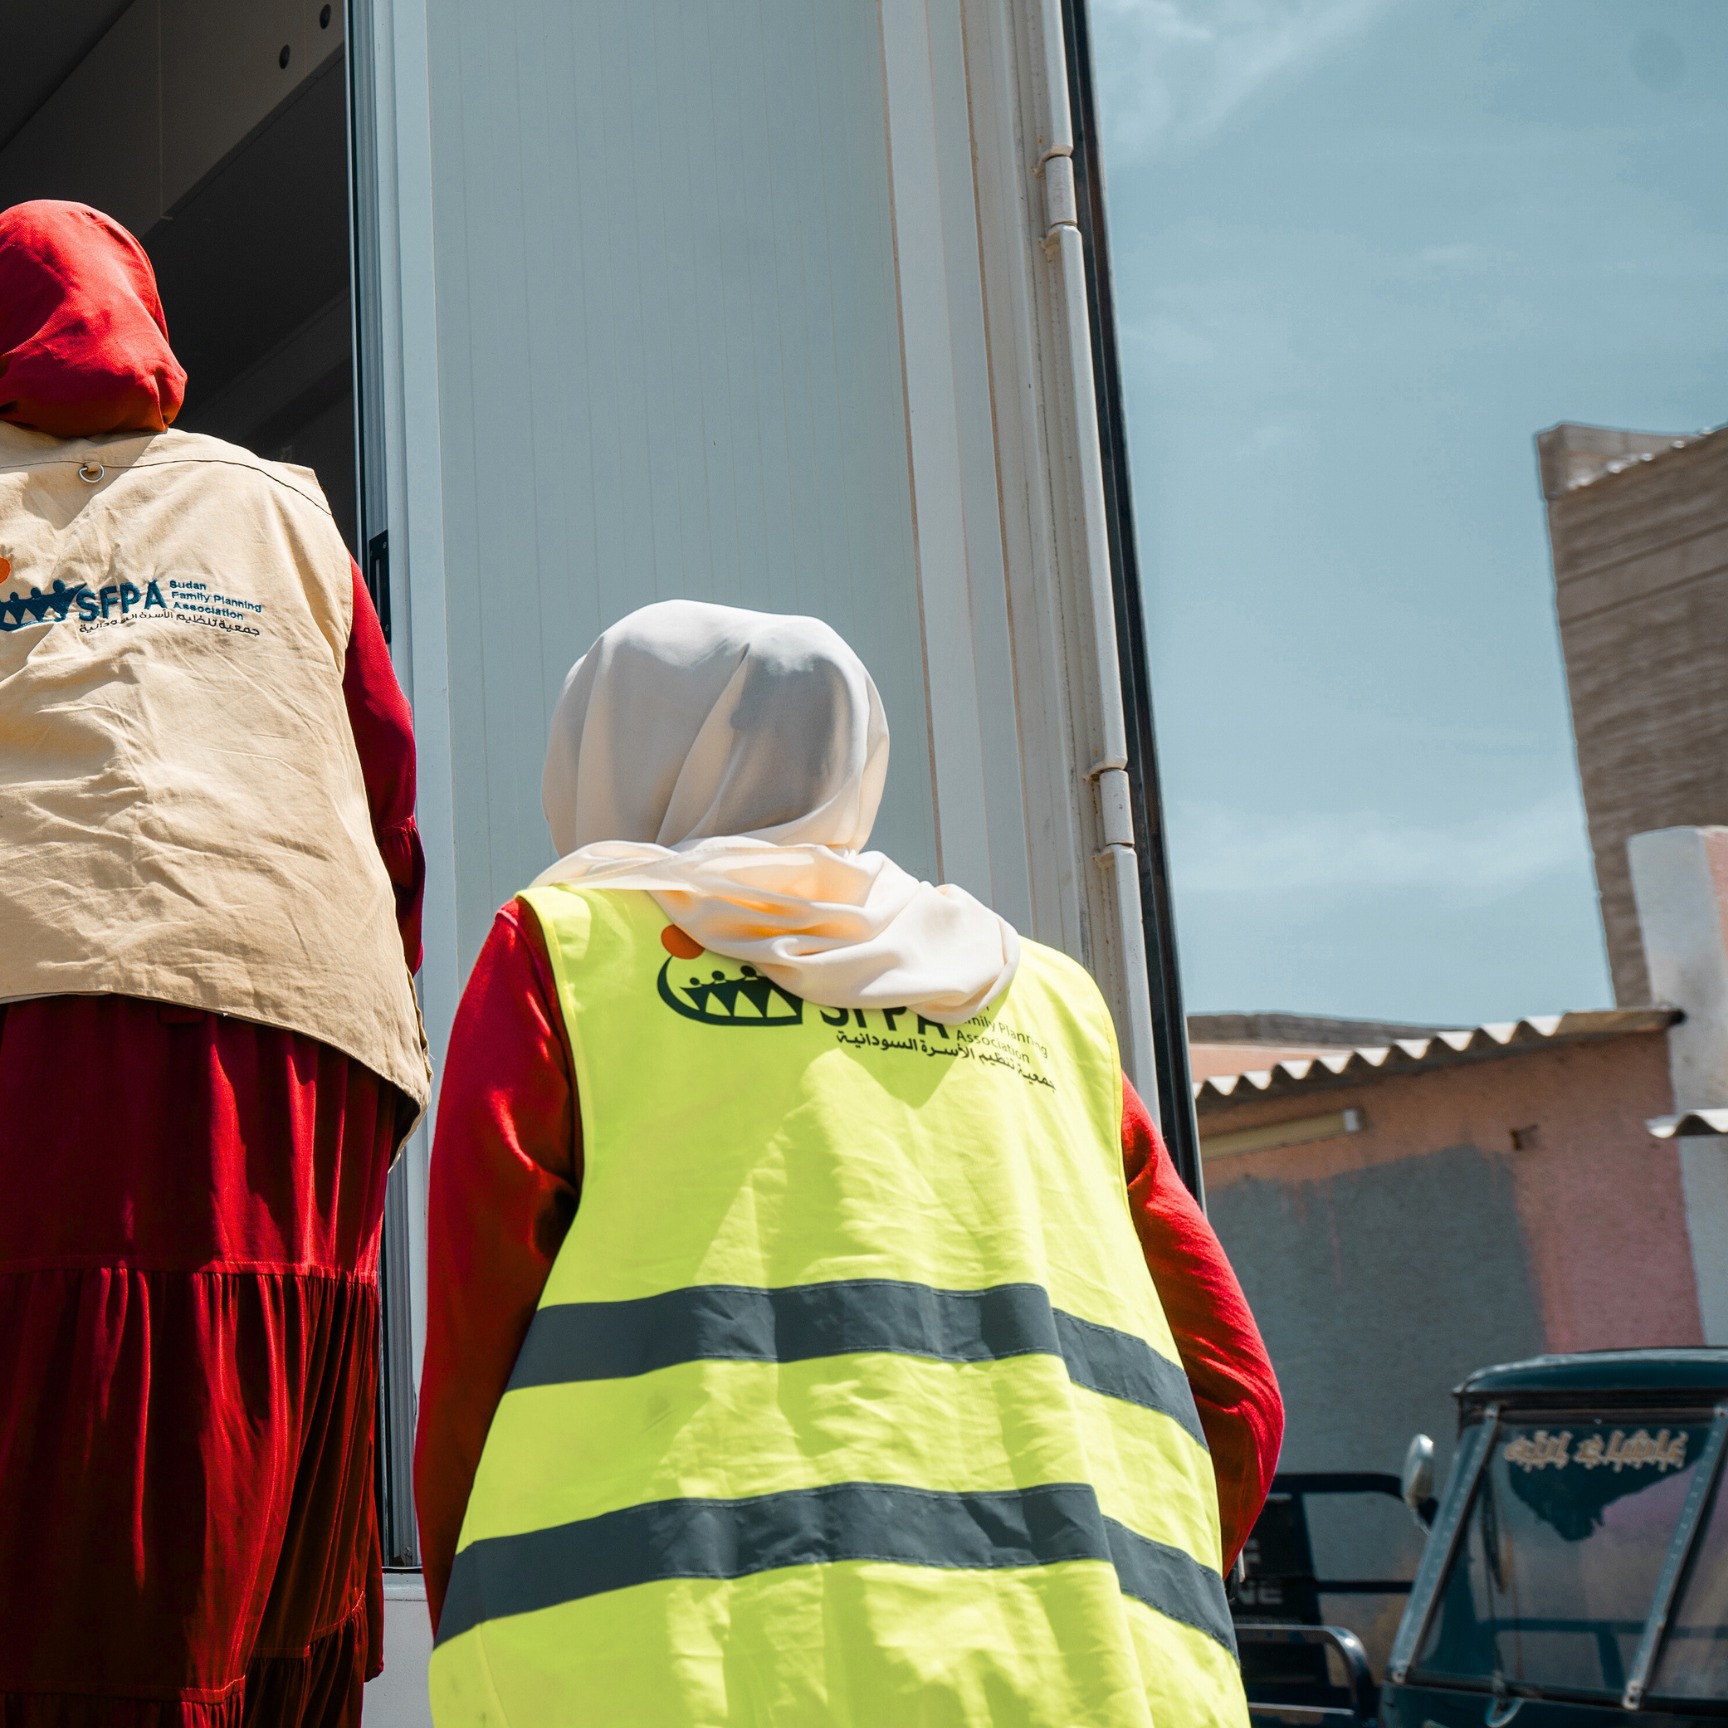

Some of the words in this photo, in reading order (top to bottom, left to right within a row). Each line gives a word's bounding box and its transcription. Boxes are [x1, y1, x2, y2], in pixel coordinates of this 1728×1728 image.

[169, 579, 207, 591] Sudan
[76, 578, 167, 621] SFPA
[171, 591, 210, 604] Family
[213, 594, 262, 613] Planning
[173, 601, 244, 620] Association
[835, 1030, 919, 1052] السودانية
[920, 1039, 975, 1060] الأسرة
[956, 1029, 1031, 1064] Association
[978, 1051, 1016, 1071] تنظيم
